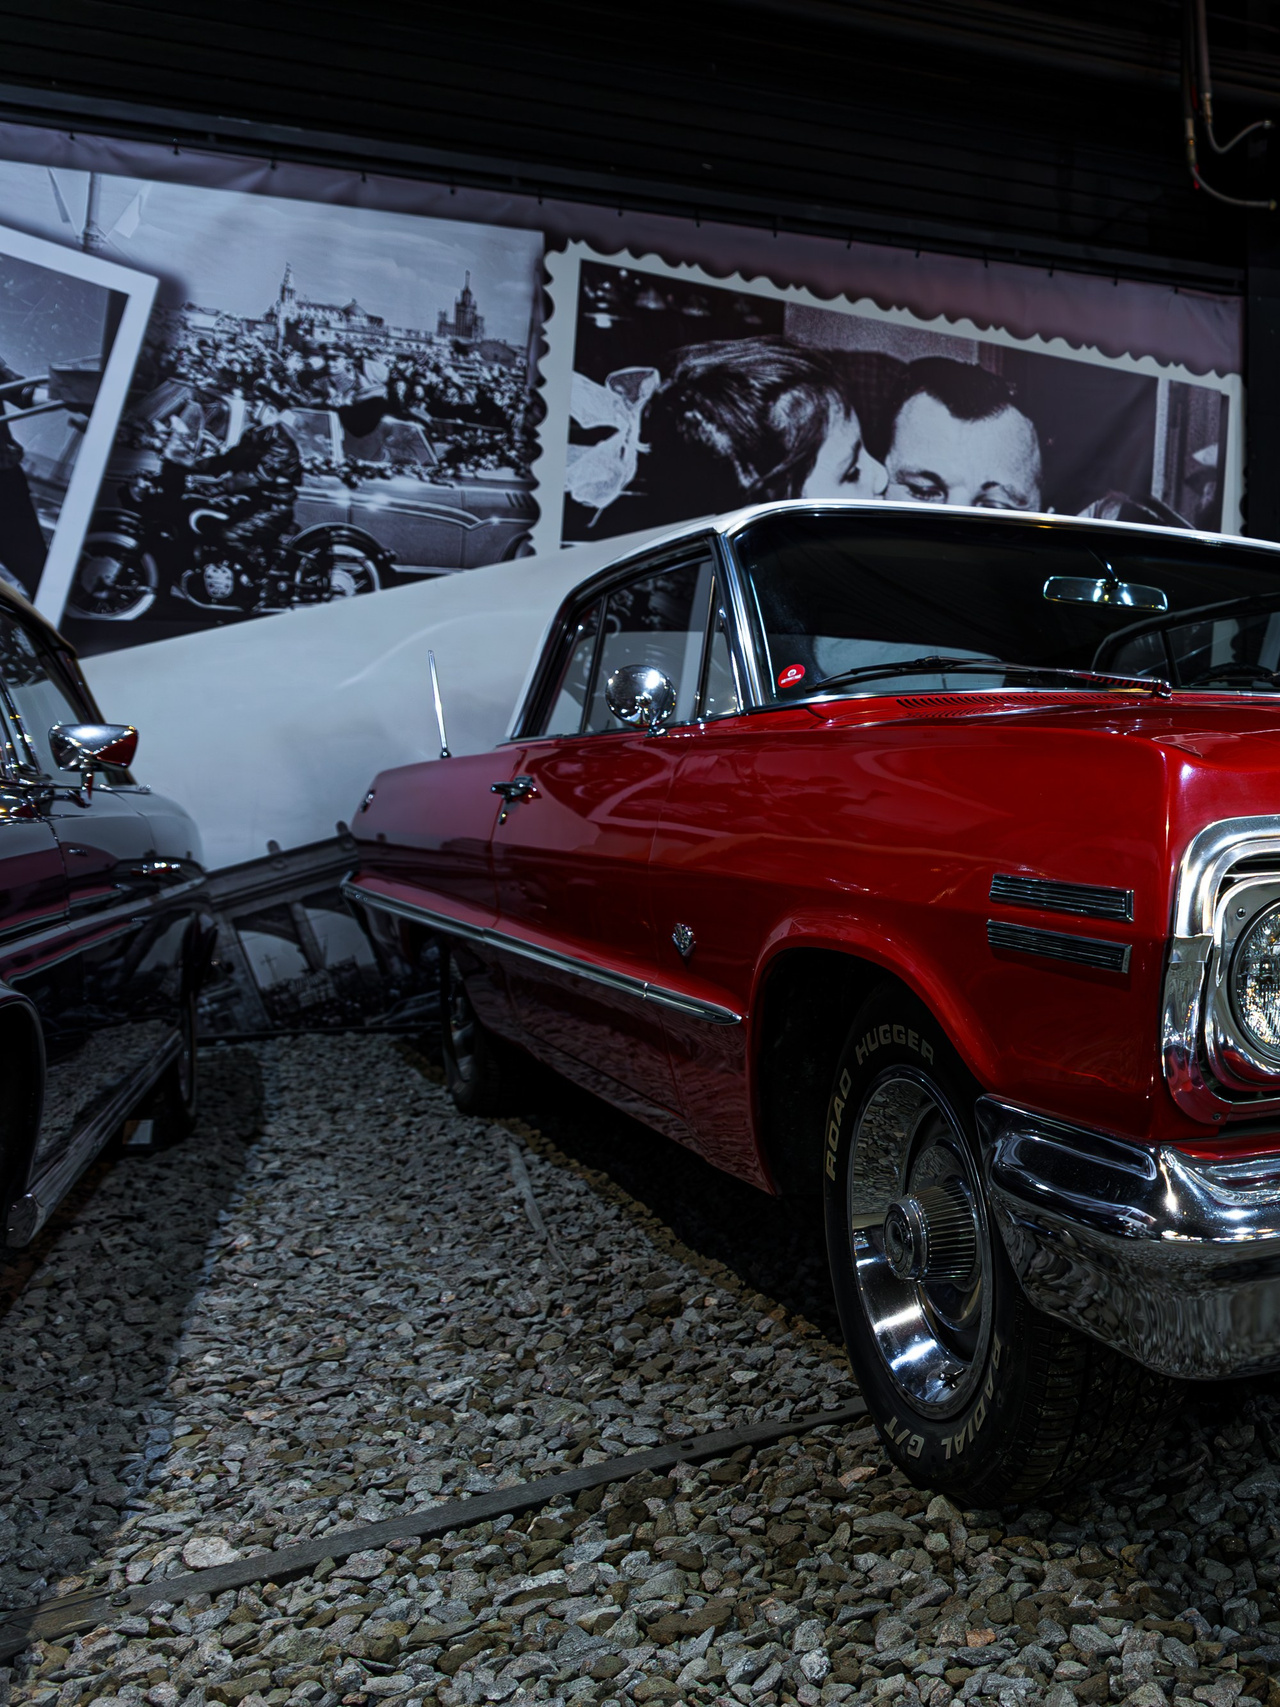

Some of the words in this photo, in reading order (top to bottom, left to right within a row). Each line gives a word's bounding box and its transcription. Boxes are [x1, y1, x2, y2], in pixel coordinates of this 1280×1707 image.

[826, 1067, 852, 1182] ROAD
[855, 1023, 934, 1066] HUGGER
[883, 1415, 925, 1459] G/T
[941, 1331, 1001, 1460] RADIAL
